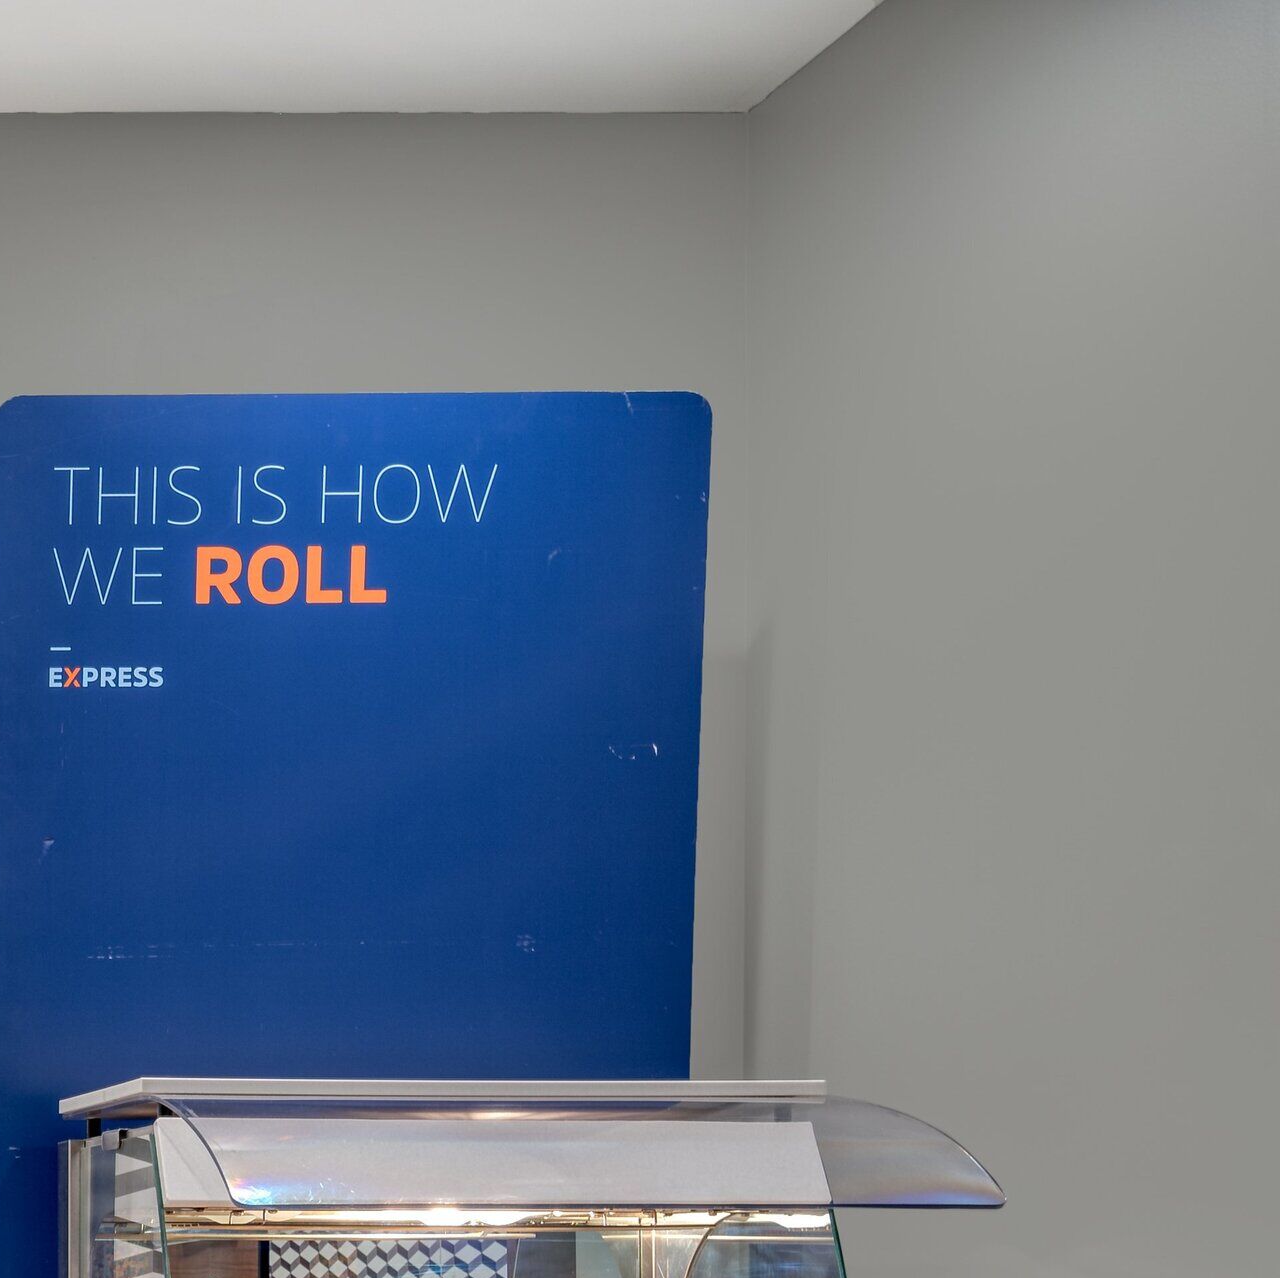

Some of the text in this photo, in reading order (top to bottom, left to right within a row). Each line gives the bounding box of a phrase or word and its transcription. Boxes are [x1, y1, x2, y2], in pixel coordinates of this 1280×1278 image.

[53, 463, 499, 526] THIS IS HOW
[52, 544, 388, 606] WE ROLL
[48, 666, 164, 688] EXPRESS
